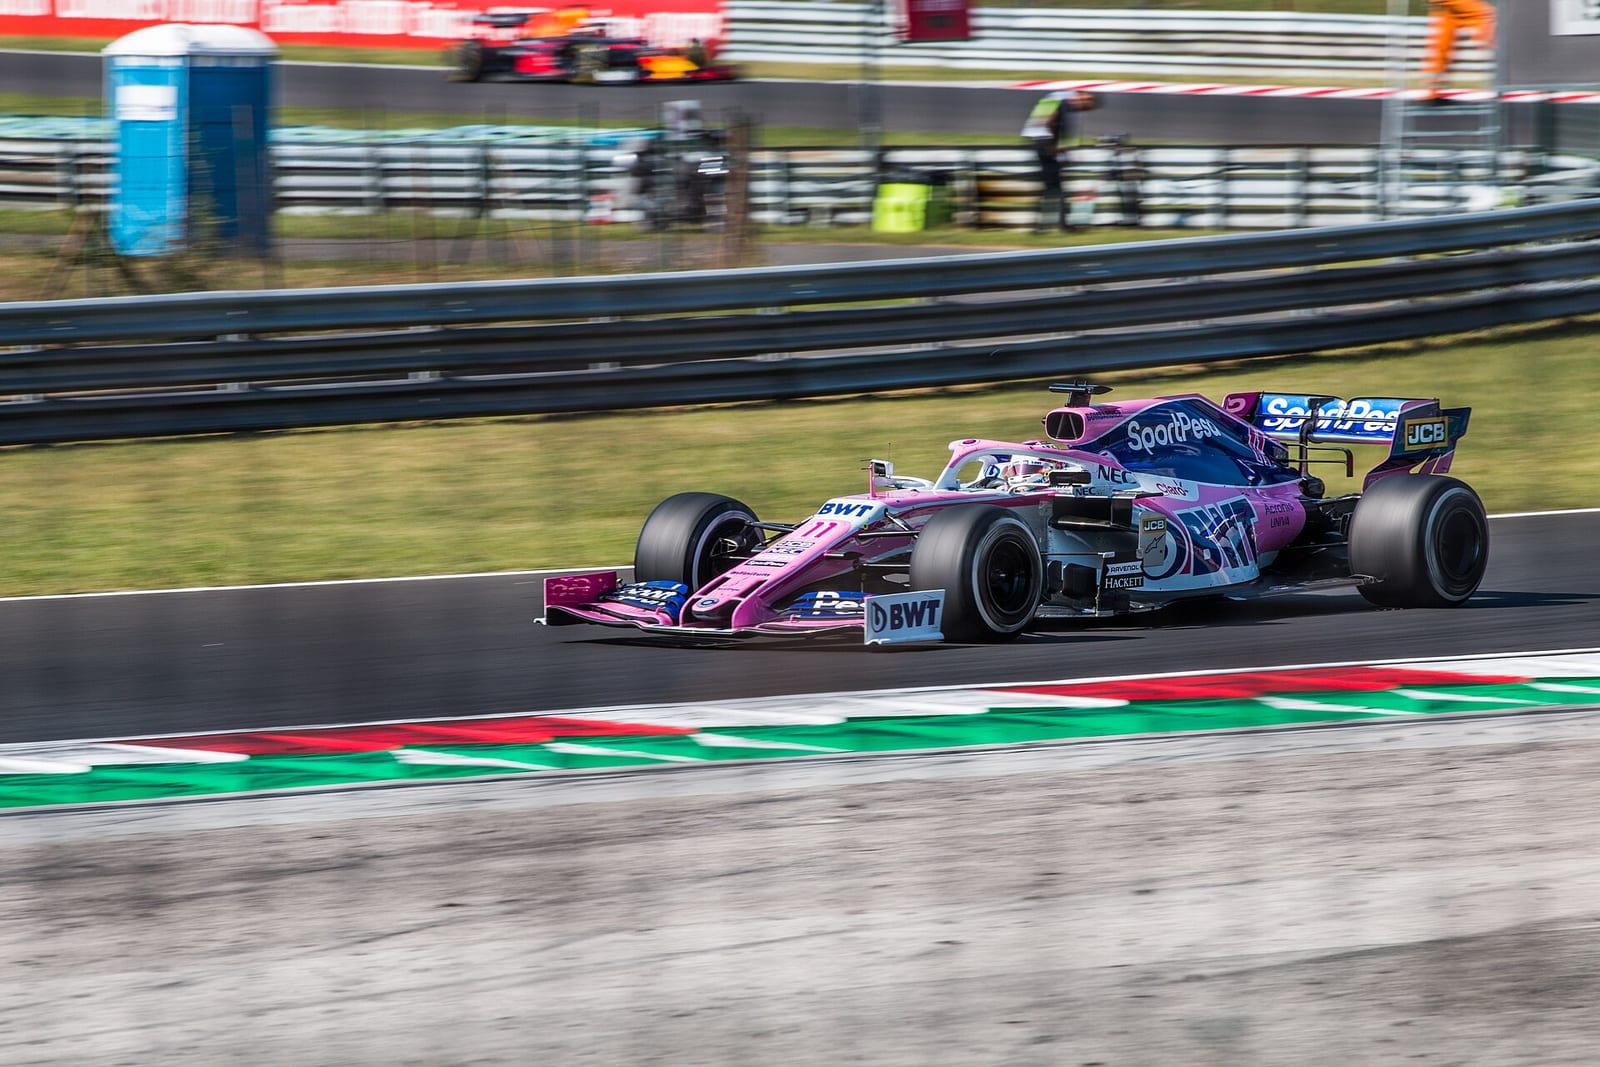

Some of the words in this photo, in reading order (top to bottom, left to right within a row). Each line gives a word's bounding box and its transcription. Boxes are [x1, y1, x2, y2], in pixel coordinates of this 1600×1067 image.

[1127, 412, 1221, 455] SportPesa
[1408, 423, 1445, 444] JCB
[1098, 464, 1137, 484] NEC
[1075, 486, 1097, 496] NEC
[818, 503, 873, 517] BWT
[802, 521, 837, 538] 11
[1144, 520, 1165, 531] JCB
[1105, 576, 1143, 589] HACKETT
[889, 600, 940, 630] BWT
